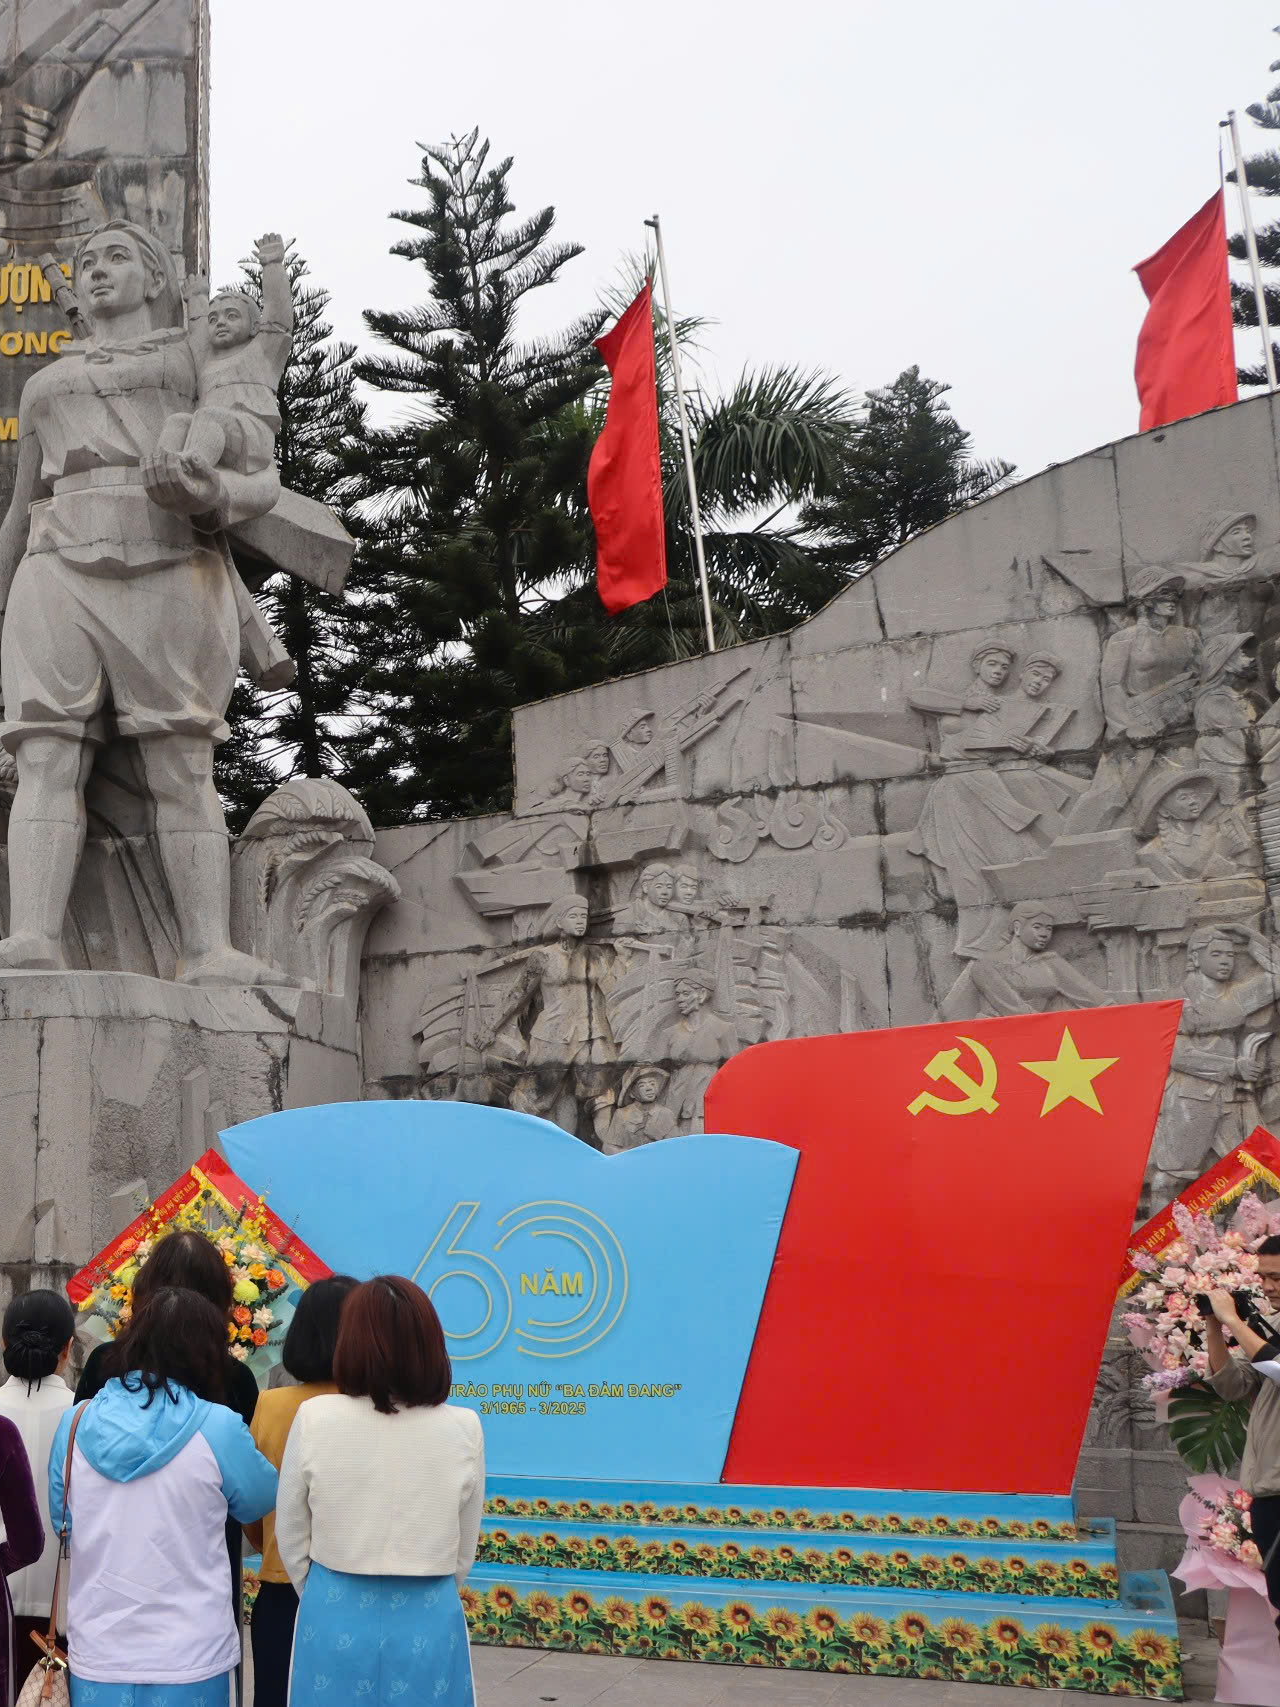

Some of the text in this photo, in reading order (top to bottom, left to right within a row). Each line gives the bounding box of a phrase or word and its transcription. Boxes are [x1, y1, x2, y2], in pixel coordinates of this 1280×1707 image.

[520, 1267, 584, 1297] NĂM
[448, 1380, 488, 1397] TRÀO
[492, 1384, 523, 1401] PHỤ
[528, 1381, 553, 1398] NỮ
[480, 1401, 527, 1416] 3/1965
[539, 1401, 587, 1416] 3/2025
